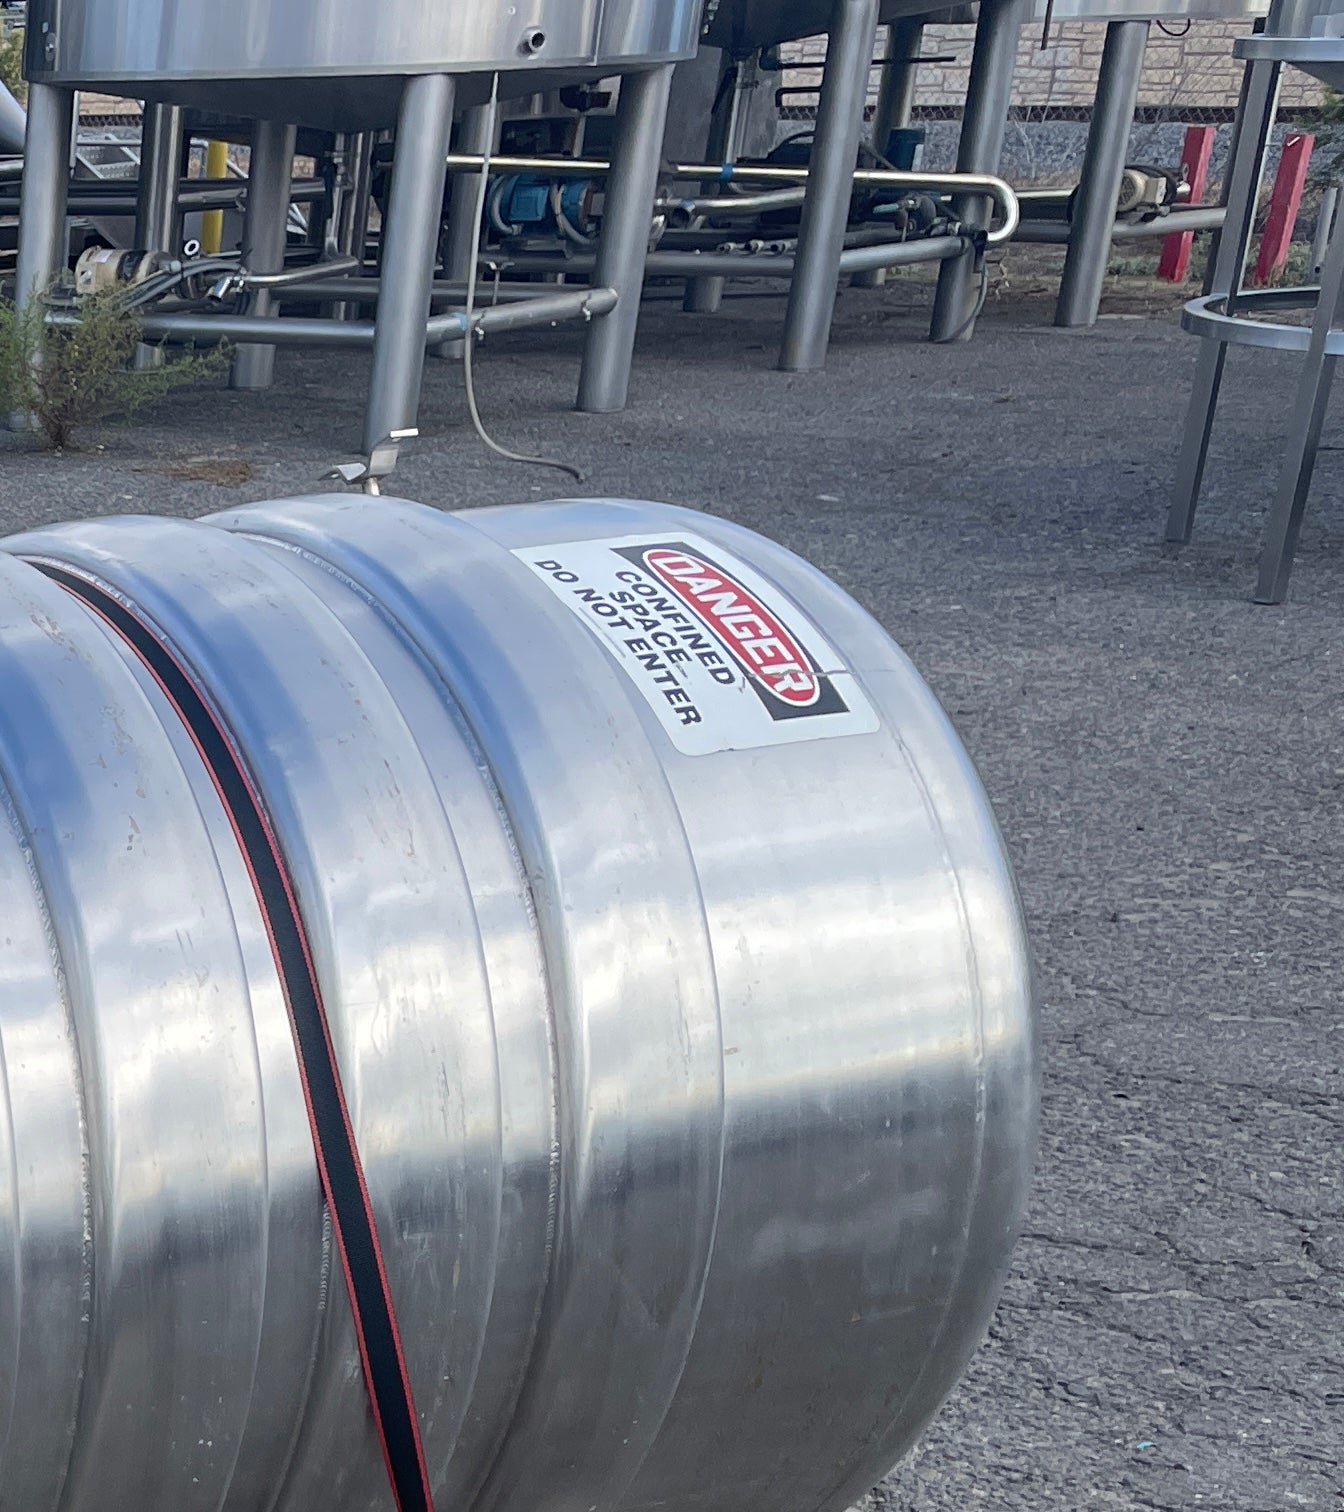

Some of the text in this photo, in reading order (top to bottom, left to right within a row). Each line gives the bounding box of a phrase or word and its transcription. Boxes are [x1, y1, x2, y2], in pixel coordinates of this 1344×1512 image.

[534, 560, 702, 726] DO NOT ENTER
[608, 590, 692, 664] SPACE
[615, 570, 736, 686] CONFINED
[653, 556, 814, 694] DANGER
